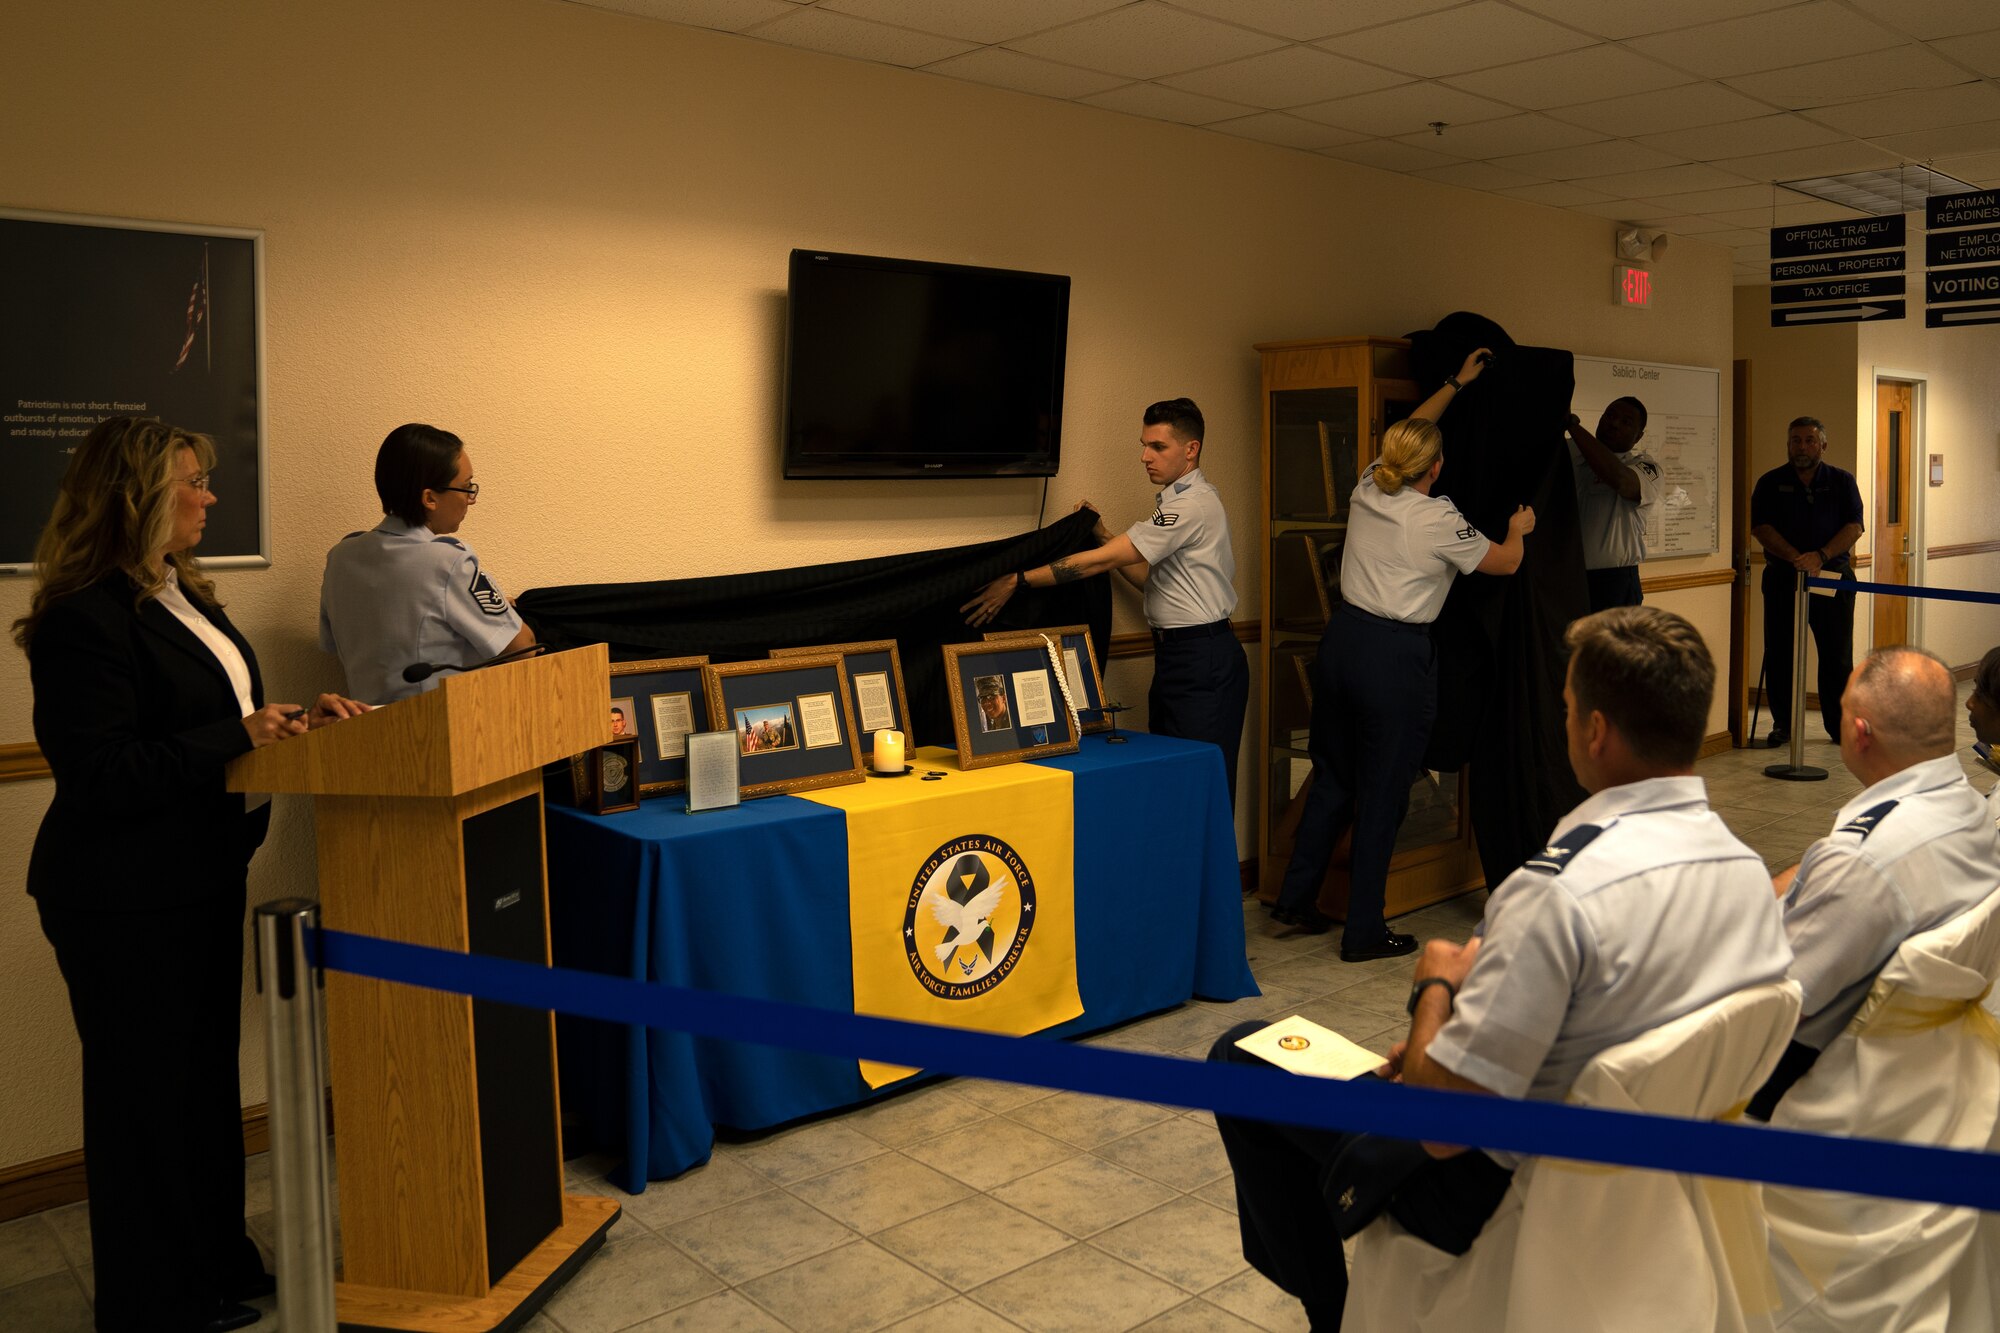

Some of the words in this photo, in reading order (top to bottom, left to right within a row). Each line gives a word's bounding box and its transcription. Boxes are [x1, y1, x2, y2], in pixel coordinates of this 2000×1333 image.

[1945, 194, 1995, 210] AIRMAN
[1785, 228, 1835, 242] OFFICIAL
[1841, 221, 1889, 236] TRAVEL/
[1959, 232, 2000, 247] EMPLO
[1807, 236, 1867, 250] TICKETING
[1775, 263, 1833, 276] PERSONAL
[1838, 256, 1900, 271] PROPERTY
[1626, 269, 1649, 305] EXIT
[1803, 287, 1824, 297] TAX
[1829, 283, 1870, 295] OFFICE
[1932, 275, 2000, 295] VOTING
[1612, 364, 1637, 379] Sablich
[1638, 367, 1660, 381] Center
[18, 399, 62, 409] Patriotism
[62, 400, 70, 409] is
[71, 401, 86, 410] not
[113, 401, 147, 411] frenzied
[3, 413, 46, 423] outbursts
[46, 413, 57, 423] of
[58, 415, 97, 424] emotion,
[10, 427, 27, 437] and
[28, 428, 57, 439] steady
[58, 427, 90, 437] dedicat
[908, 860, 939, 909] UNITED
[941, 839, 981, 860] STATES
[983, 840, 1003, 855] AIR
[1004, 851, 1030, 888] FORCE
[909, 951, 921, 974] AIR
[920, 969, 947, 995] FORCE
[950, 976, 998, 997] FAMILIES
[998, 927, 1030, 977] FOREVER
